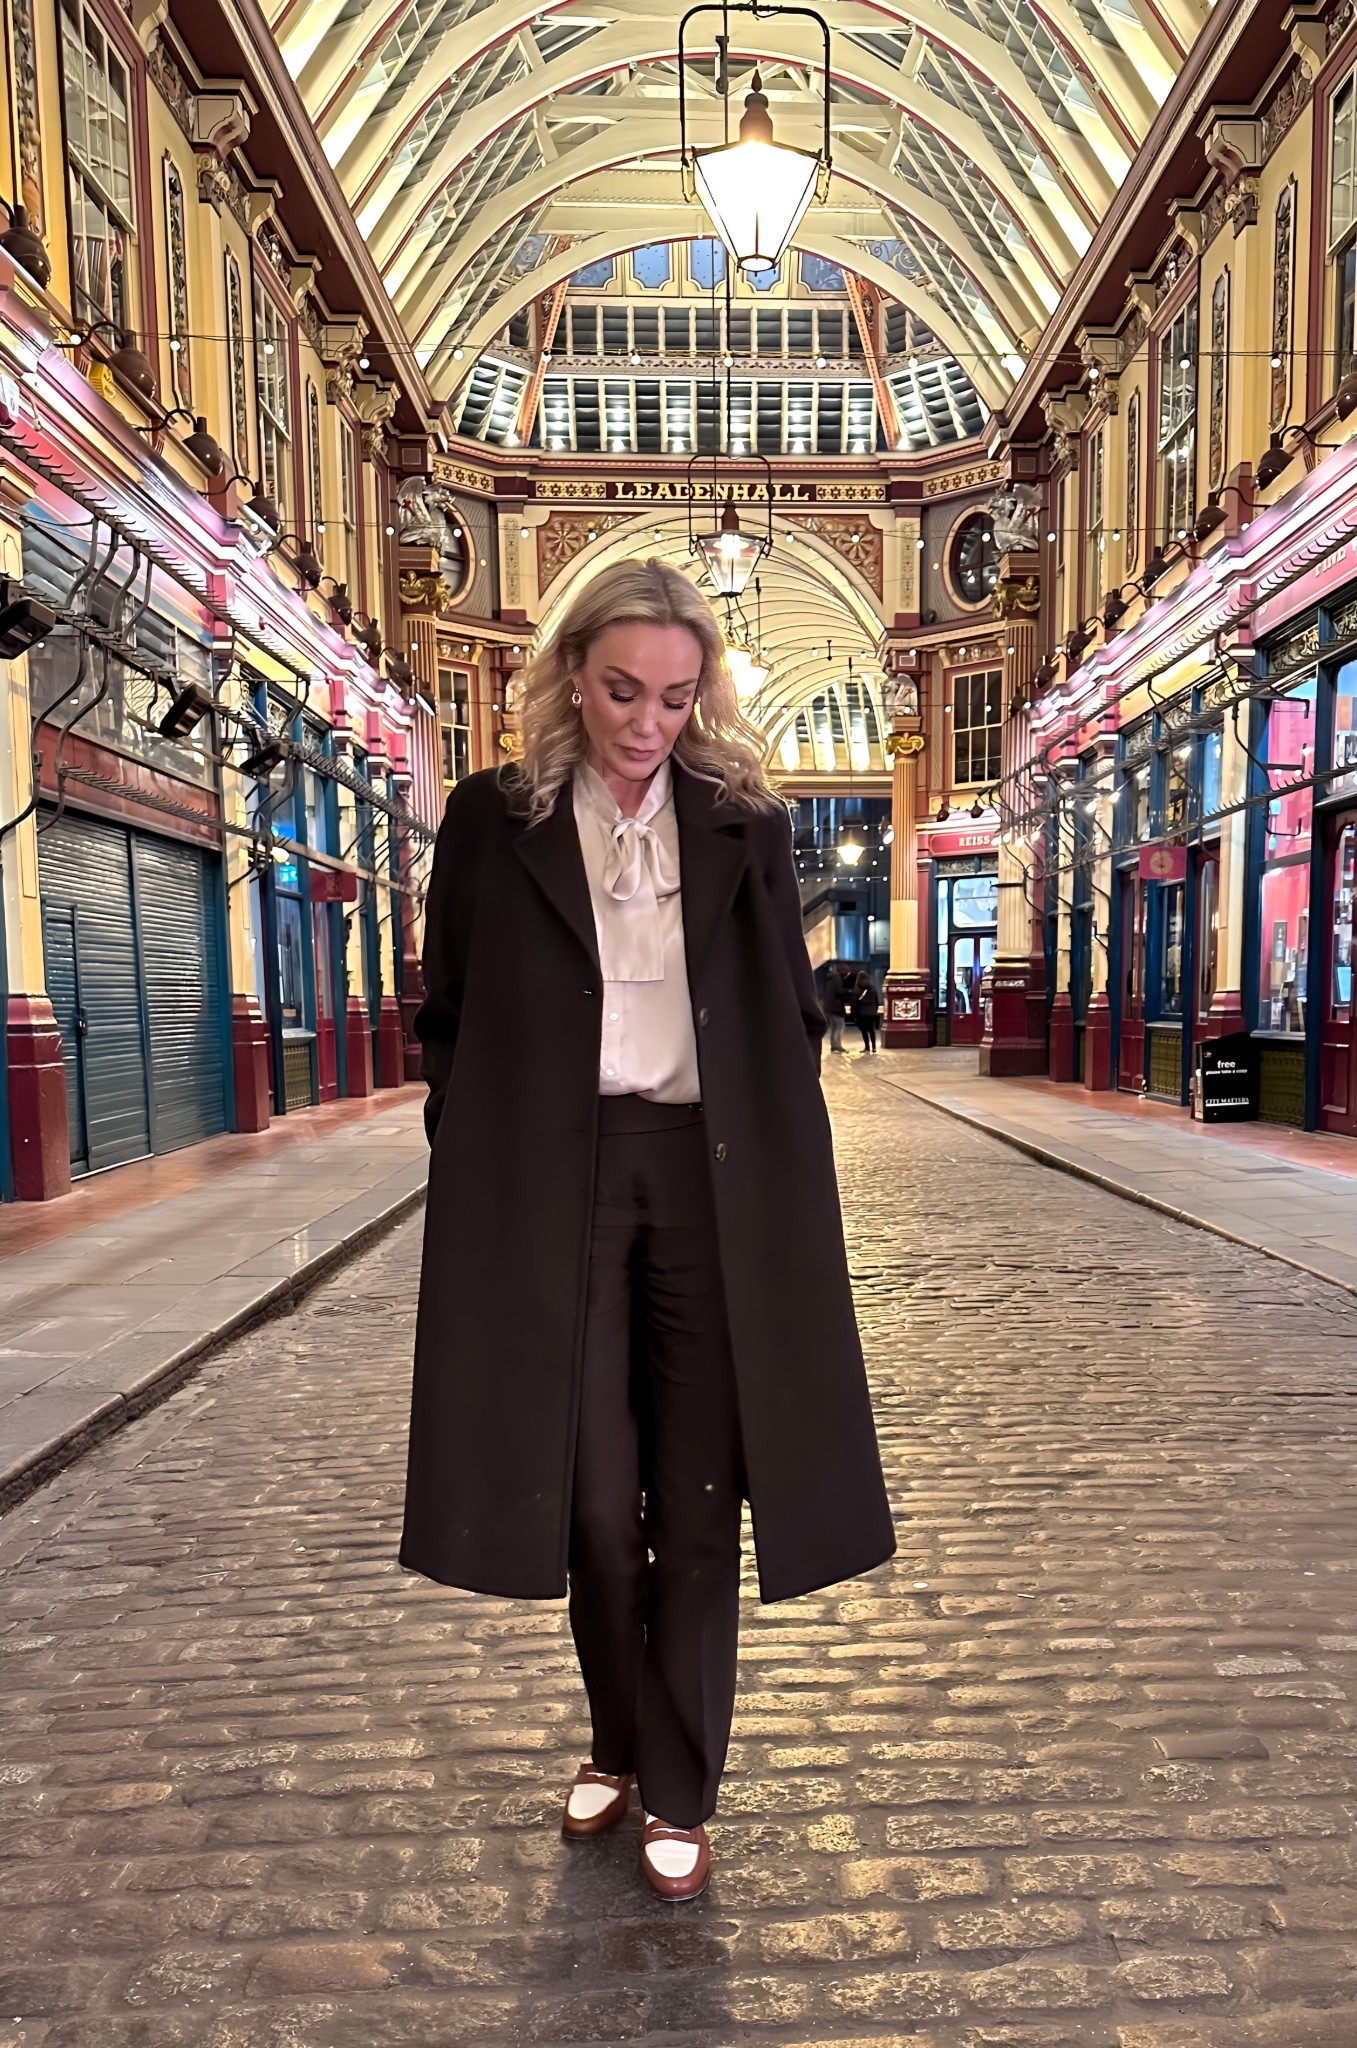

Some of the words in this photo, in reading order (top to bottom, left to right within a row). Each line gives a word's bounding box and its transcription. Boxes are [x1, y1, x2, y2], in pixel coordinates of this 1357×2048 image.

[616, 482, 809, 500] LEADENHALL
[959, 835, 990, 847] REISS
[1217, 1060, 1236, 1069] free
